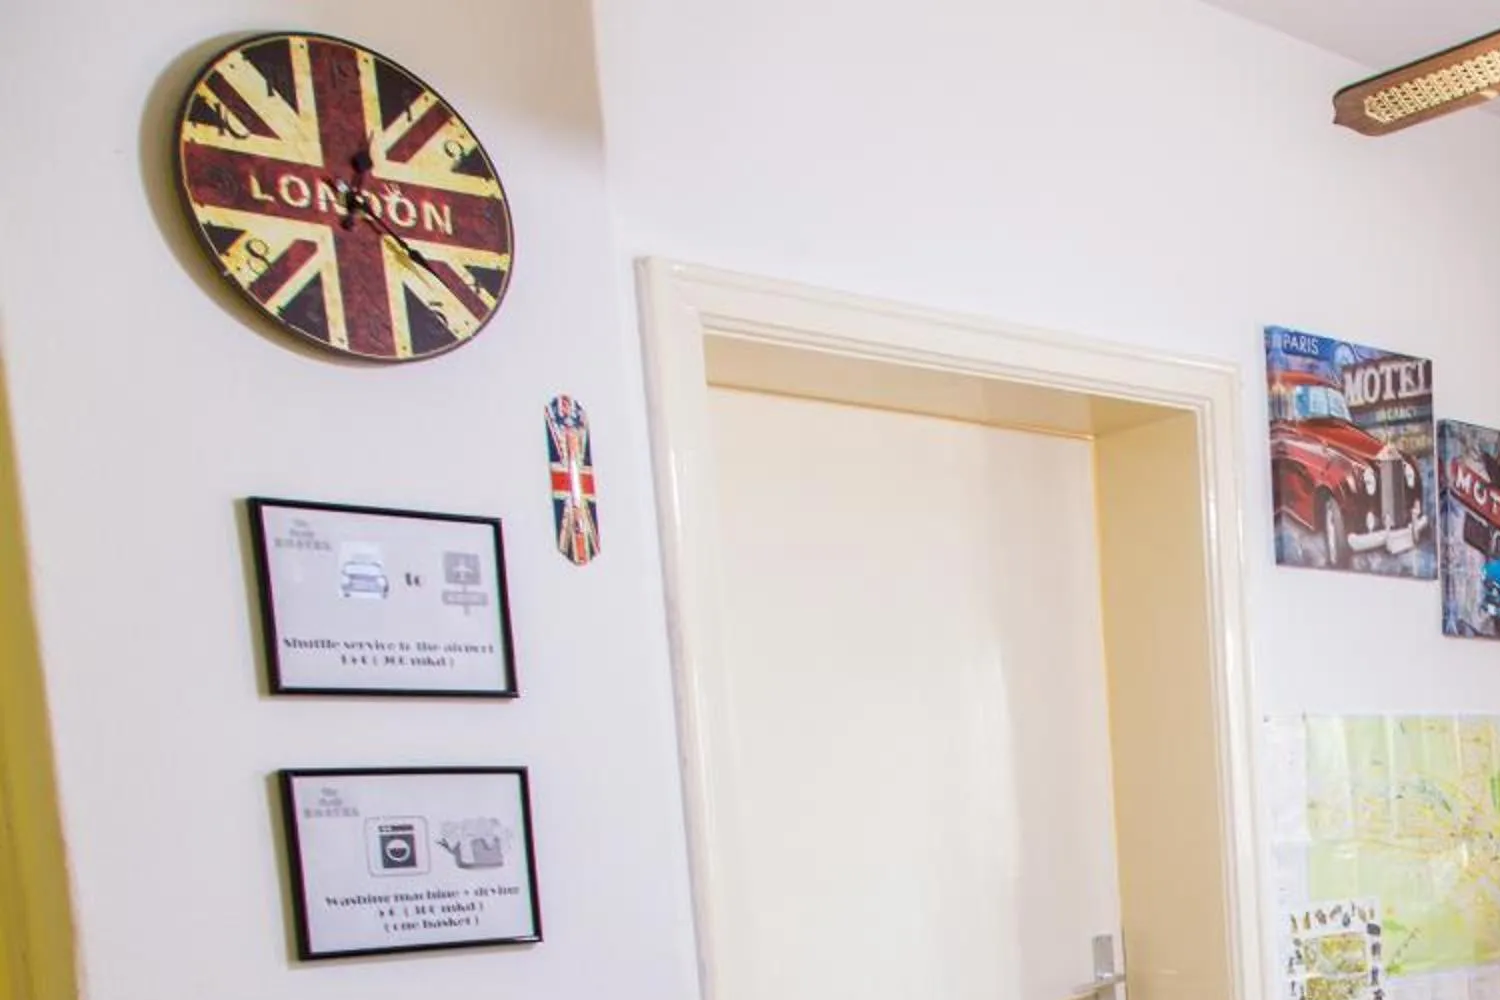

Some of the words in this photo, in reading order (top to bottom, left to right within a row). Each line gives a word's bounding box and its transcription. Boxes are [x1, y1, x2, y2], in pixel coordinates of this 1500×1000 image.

[1282, 332, 1319, 354] PARIS
[344, 639, 397, 651] service
[325, 893, 390, 908] Washing
